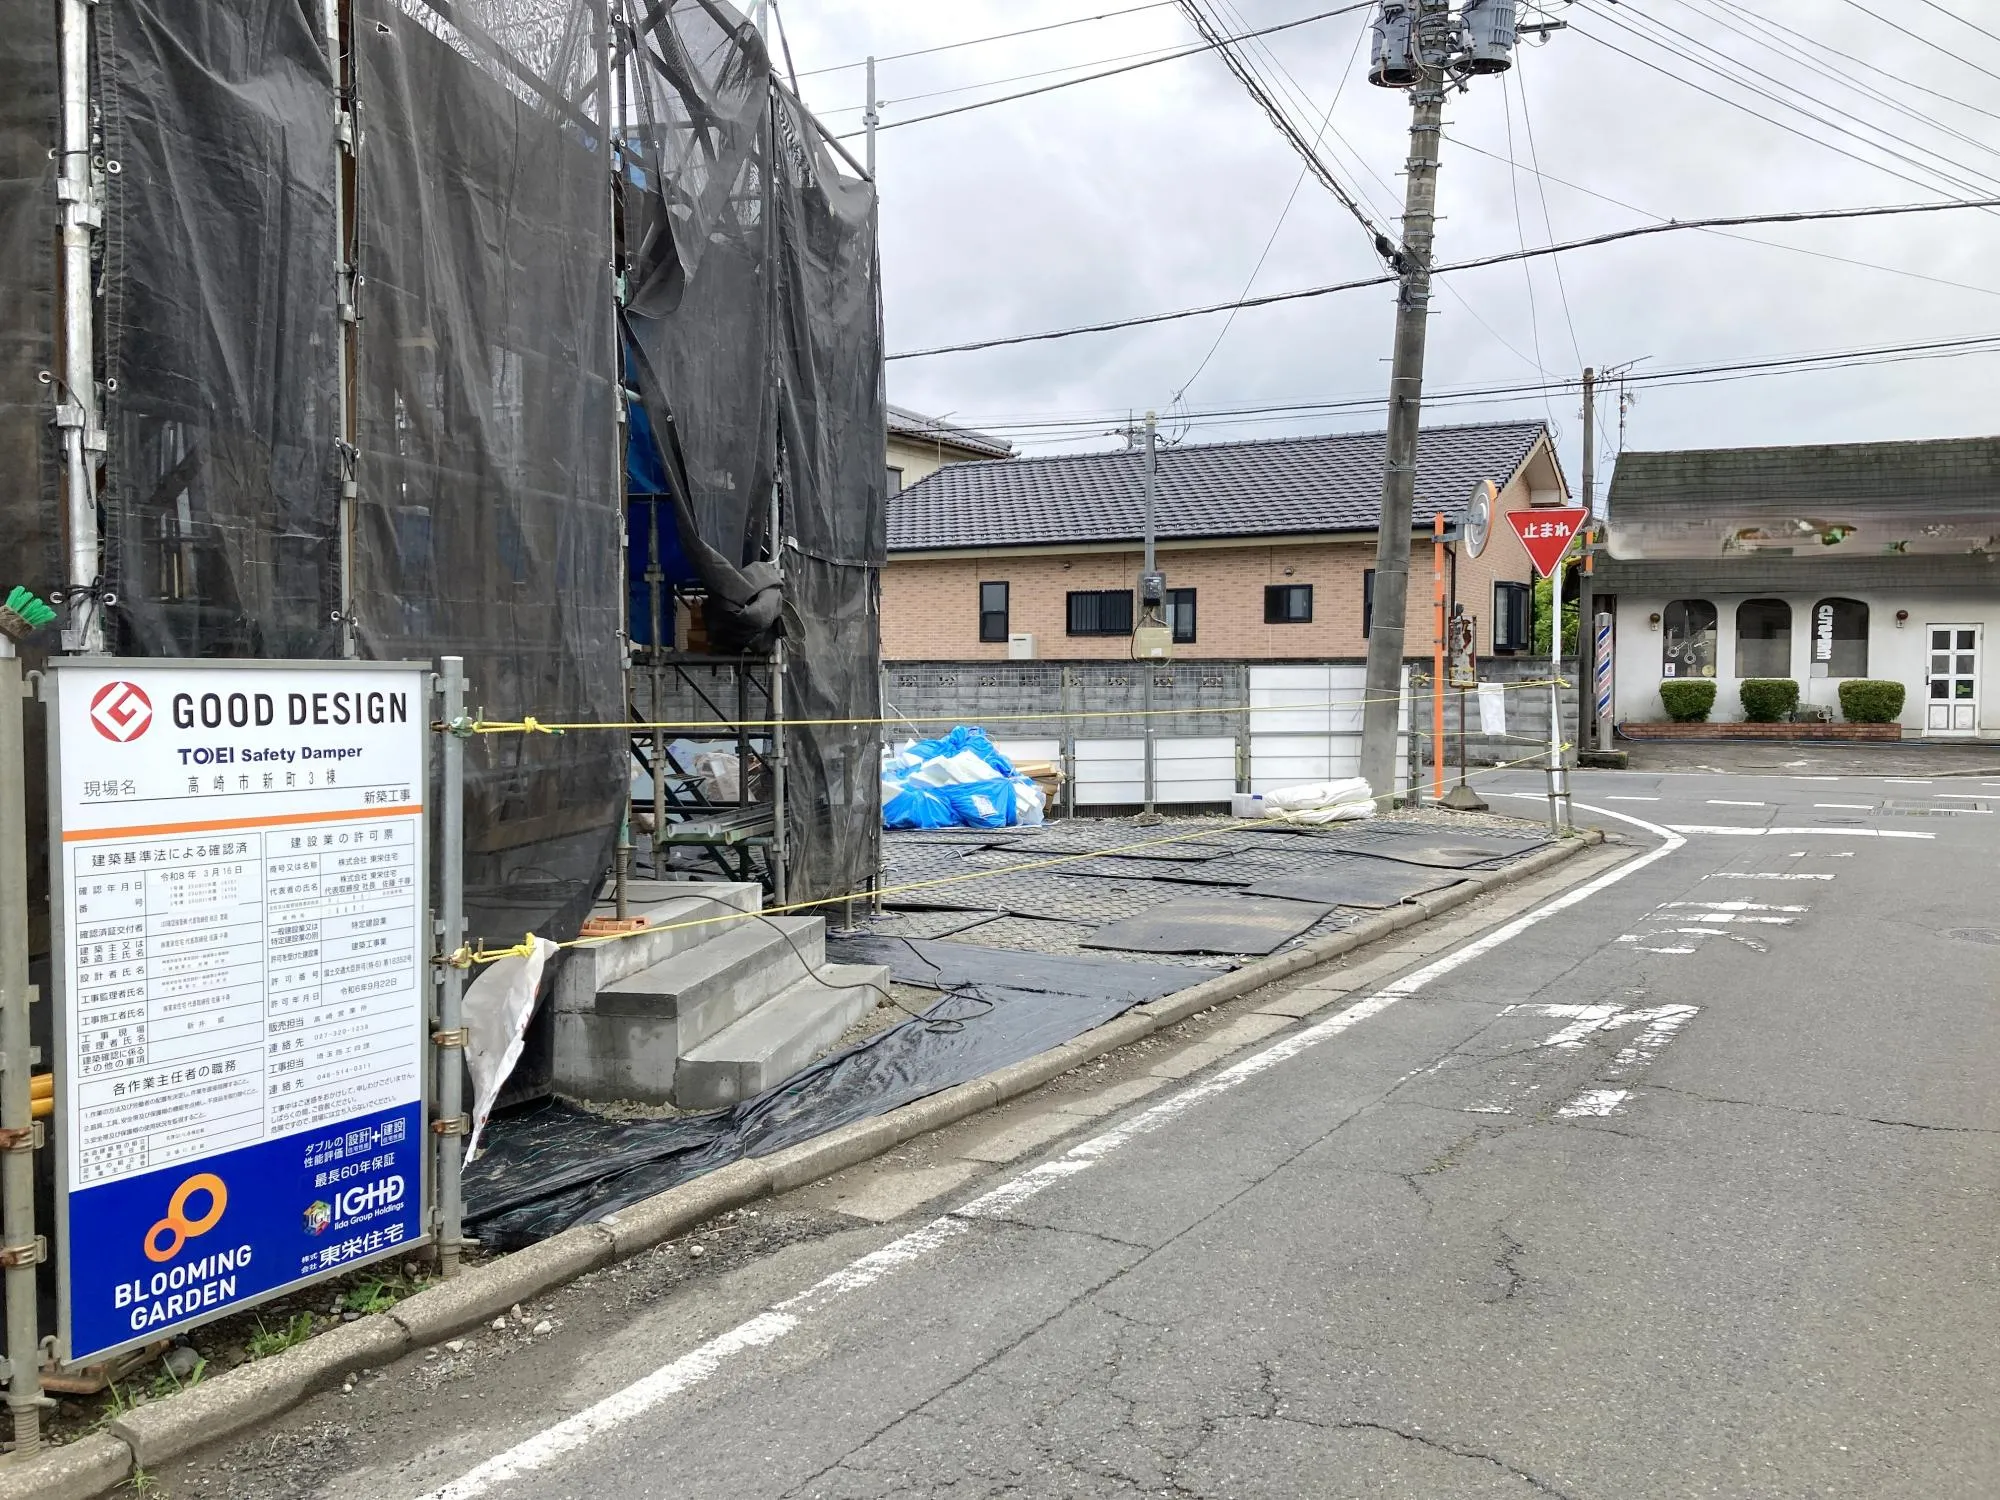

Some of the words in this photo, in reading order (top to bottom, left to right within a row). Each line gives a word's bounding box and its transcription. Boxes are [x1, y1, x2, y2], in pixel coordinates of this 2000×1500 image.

[1522, 520, 1571, 540] 止まれ
[172, 692, 274, 729] GOOD
[288, 691, 408, 727] DESIGN
[178, 746, 235, 766] TOEI
[241, 747, 295, 764] Safety
[301, 745, 362, 762] Damper
[83, 779, 137, 797] 現場名
[187, 768, 337, 795] 高崎市新町3棟
[364, 789, 411, 806] 新築工事
[290, 829, 394, 849] 建設業の許可票
[92, 842, 248, 867] 建築基準法による確認済
[338, 856, 367, 866] 株式会社
[370, 852, 399, 863] 東栄住宅
[269, 861, 317, 873] 商号又は名称
[340, 873, 367, 883] 株式会社
[371, 869, 397, 880] 東栄住宅
[78, 881, 143, 896] 確認年月日
[270, 883, 318, 896] 代表者の氏名
[324, 884, 360, 895] 代表取締役
[79, 898, 143, 913] 番号
[79, 924, 143, 939] 確認済証交付者
[270, 923, 318, 935] 一般建設業又は
[351, 917, 387, 929] 特定建設業
[270, 932, 319, 945] 特定建設業の別
[351, 938, 387, 951] 建築工事業
[80, 941, 143, 954] 建築主又は
[270, 949, 319, 963] 許可を受けた建設業
[80, 949, 144, 964] 築造主氏名
[80, 965, 145, 983] 設計者氏名
[271, 971, 319, 986] 許可番号
[81, 987, 145, 1004] 工事監理者氏名
[340, 978, 397, 996] 令和6年9月22日
[270, 992, 320, 1009] 許可年月日
[81, 1008, 145, 1026] 工事施工者氏名
[268, 1017, 304, 1033] 販売担当
[81, 1025, 145, 1044] 工事現場
[81, 1033, 146, 1053] 管理者氏名
[268, 1038, 304, 1054] 連絡先
[82, 1047, 145, 1065] 建築確認に係る
[82, 1055, 145, 1074] その他の事項
[269, 1058, 304, 1074] 工事担当
[113, 1060, 237, 1096] 各作業主任者の職務
[268, 1079, 304, 1095] 連絡先
[348, 1130, 369, 1147] 設計
[384, 1121, 403, 1136] 建設
[305, 1136, 343, 1156] ダブルの
[303, 1149, 343, 1168] 性能評価
[314, 1153, 396, 1188] 最長60年保証
[335, 1175, 405, 1221] IGHD
[350, 1212, 373, 1226] Group
[374, 1201, 404, 1217] Holdings
[319, 1222, 404, 1268] 東栄住宅
[301, 1252, 318, 1264] 株式
[114, 1243, 252, 1309] BLOOMING
[300, 1262, 318, 1274] 会社
[130, 1275, 236, 1331] GARDEN
